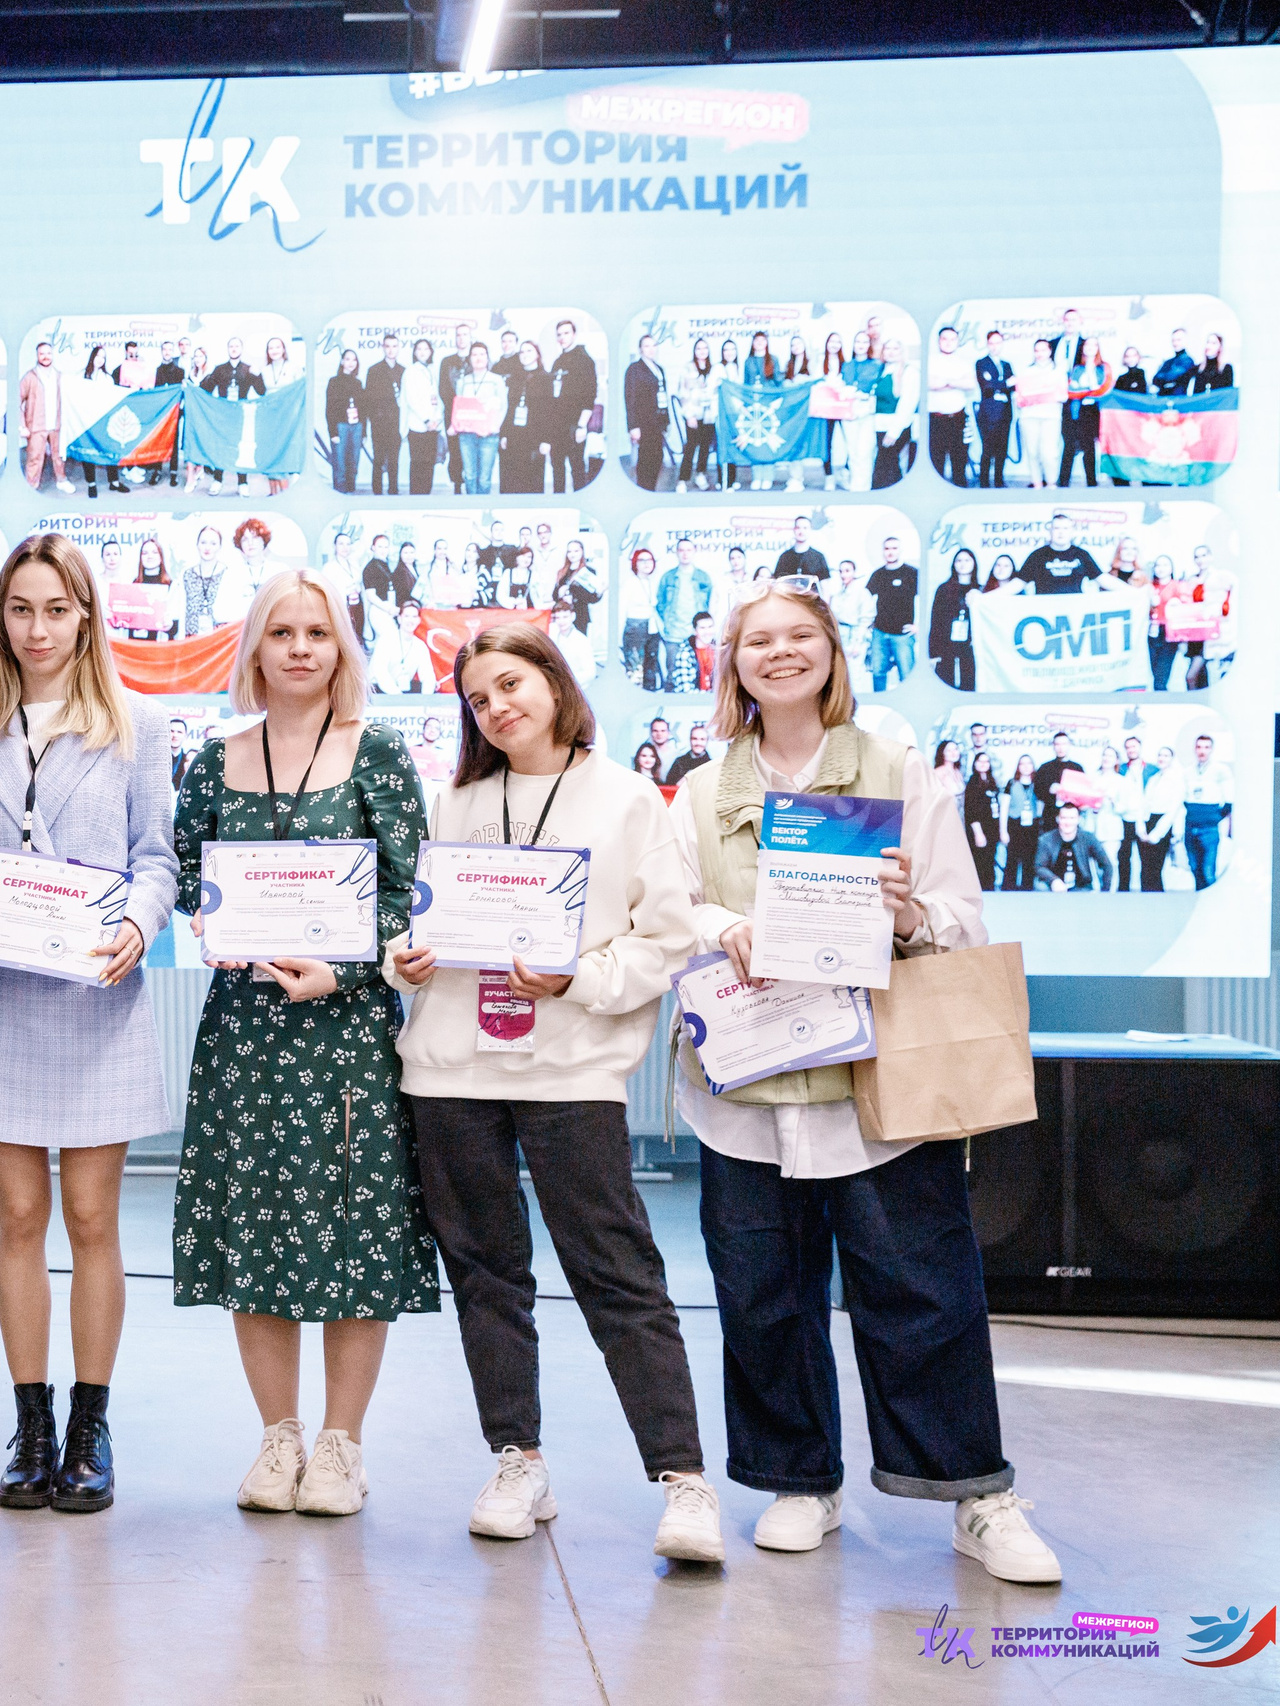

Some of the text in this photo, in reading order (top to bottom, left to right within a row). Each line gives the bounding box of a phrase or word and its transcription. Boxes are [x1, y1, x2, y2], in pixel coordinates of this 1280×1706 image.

[580, 94, 795, 130] МЕЖРЕГИОН
[343, 128, 688, 171] ТЕРРИТОРИЯ
[343, 163, 810, 217] КОММУНИКАЦИЙ
[771, 827, 808, 836] ВЕКТОР
[770, 836, 808, 846] ПОЛЁТА
[244, 870, 336, 881] СЕРТИФИКАТ
[456, 873, 547, 887] СЕРТИФИКАТ
[769, 869, 879, 886] БЛАГОДАРНОСТЬ
[2, 877, 89, 900] СЕРТИФИКАТ
[23, 891, 57, 902] УЧАСТНИКА
[742, 984, 775, 999] УЧАСТНИКА
